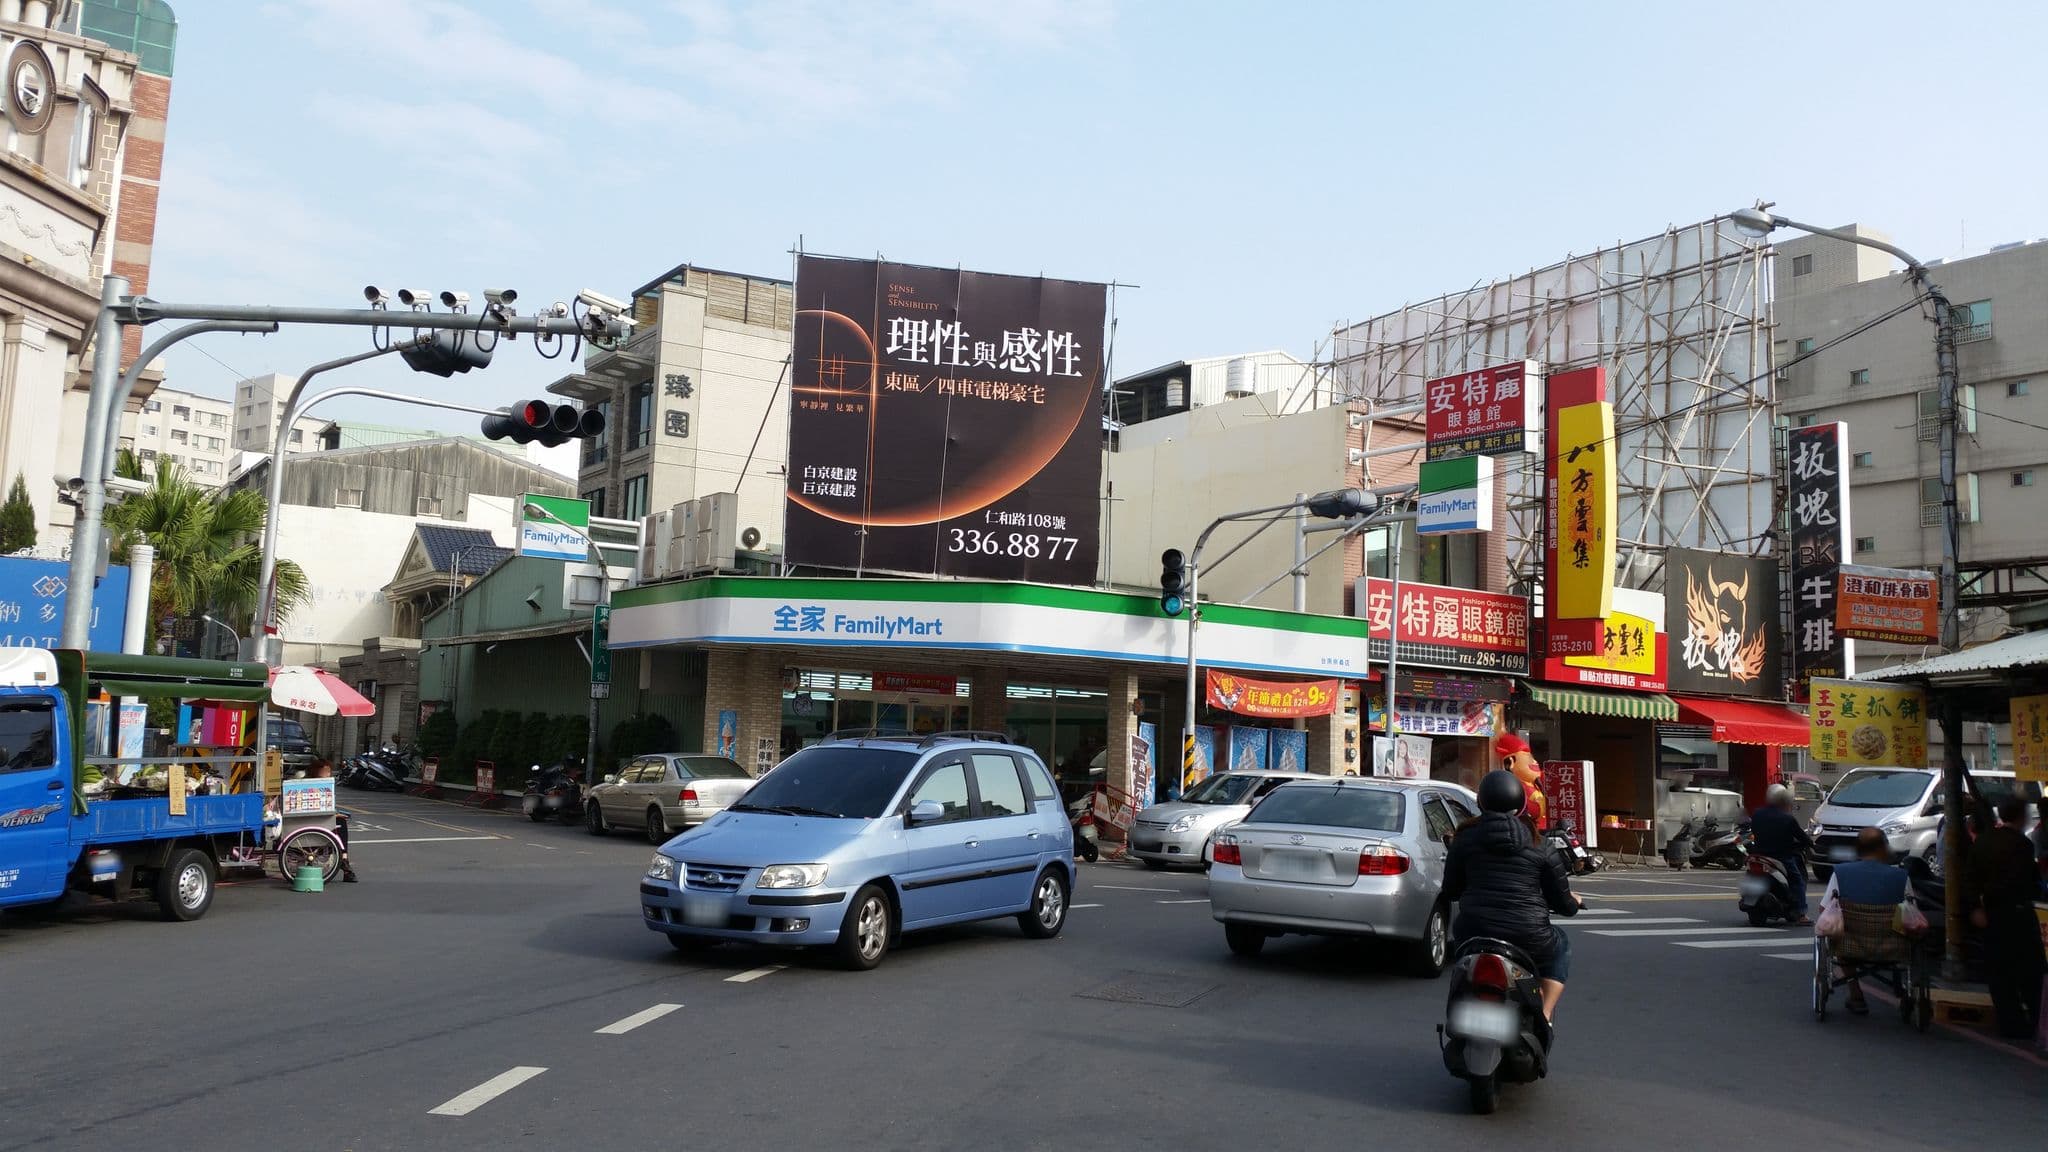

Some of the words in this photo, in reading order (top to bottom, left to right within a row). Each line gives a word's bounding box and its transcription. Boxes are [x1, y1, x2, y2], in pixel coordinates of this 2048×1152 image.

[888, 284, 915, 294] SENSE
[888, 299, 940, 311] SENSIBILITY
[886, 316, 1083, 377] 理性與感性
[1448, 404, 1502, 428] 眼鏡館
[1433, 430, 1463, 440] Fashion
[1464, 423, 1494, 434] Optical
[1495, 420, 1517, 430] Shop
[1420, 498, 1478, 517] FamilyMart
[985, 510, 1067, 531] 仁和路108號
[523, 529, 586, 546] FamilyMart
[1800, 546, 1835, 567] BK
[1845, 577, 1930, 598] 澄和排骨酥
[1461, 597, 1486, 606] Fashion
[1486, 600, 1509, 609] Optical
[773, 605, 827, 633] 全家
[834, 614, 944, 640] FamilyMart
[1369, 588, 1460, 639] 安特麗
[1462, 605, 1526, 637] 眼鏡館
[1800, 576, 1834, 652] 牛排
[1551, 640, 1593, 653] 335-2510
[1459, 653, 1476, 665] TEL:
[1476, 651, 1525, 670] 288-1699
